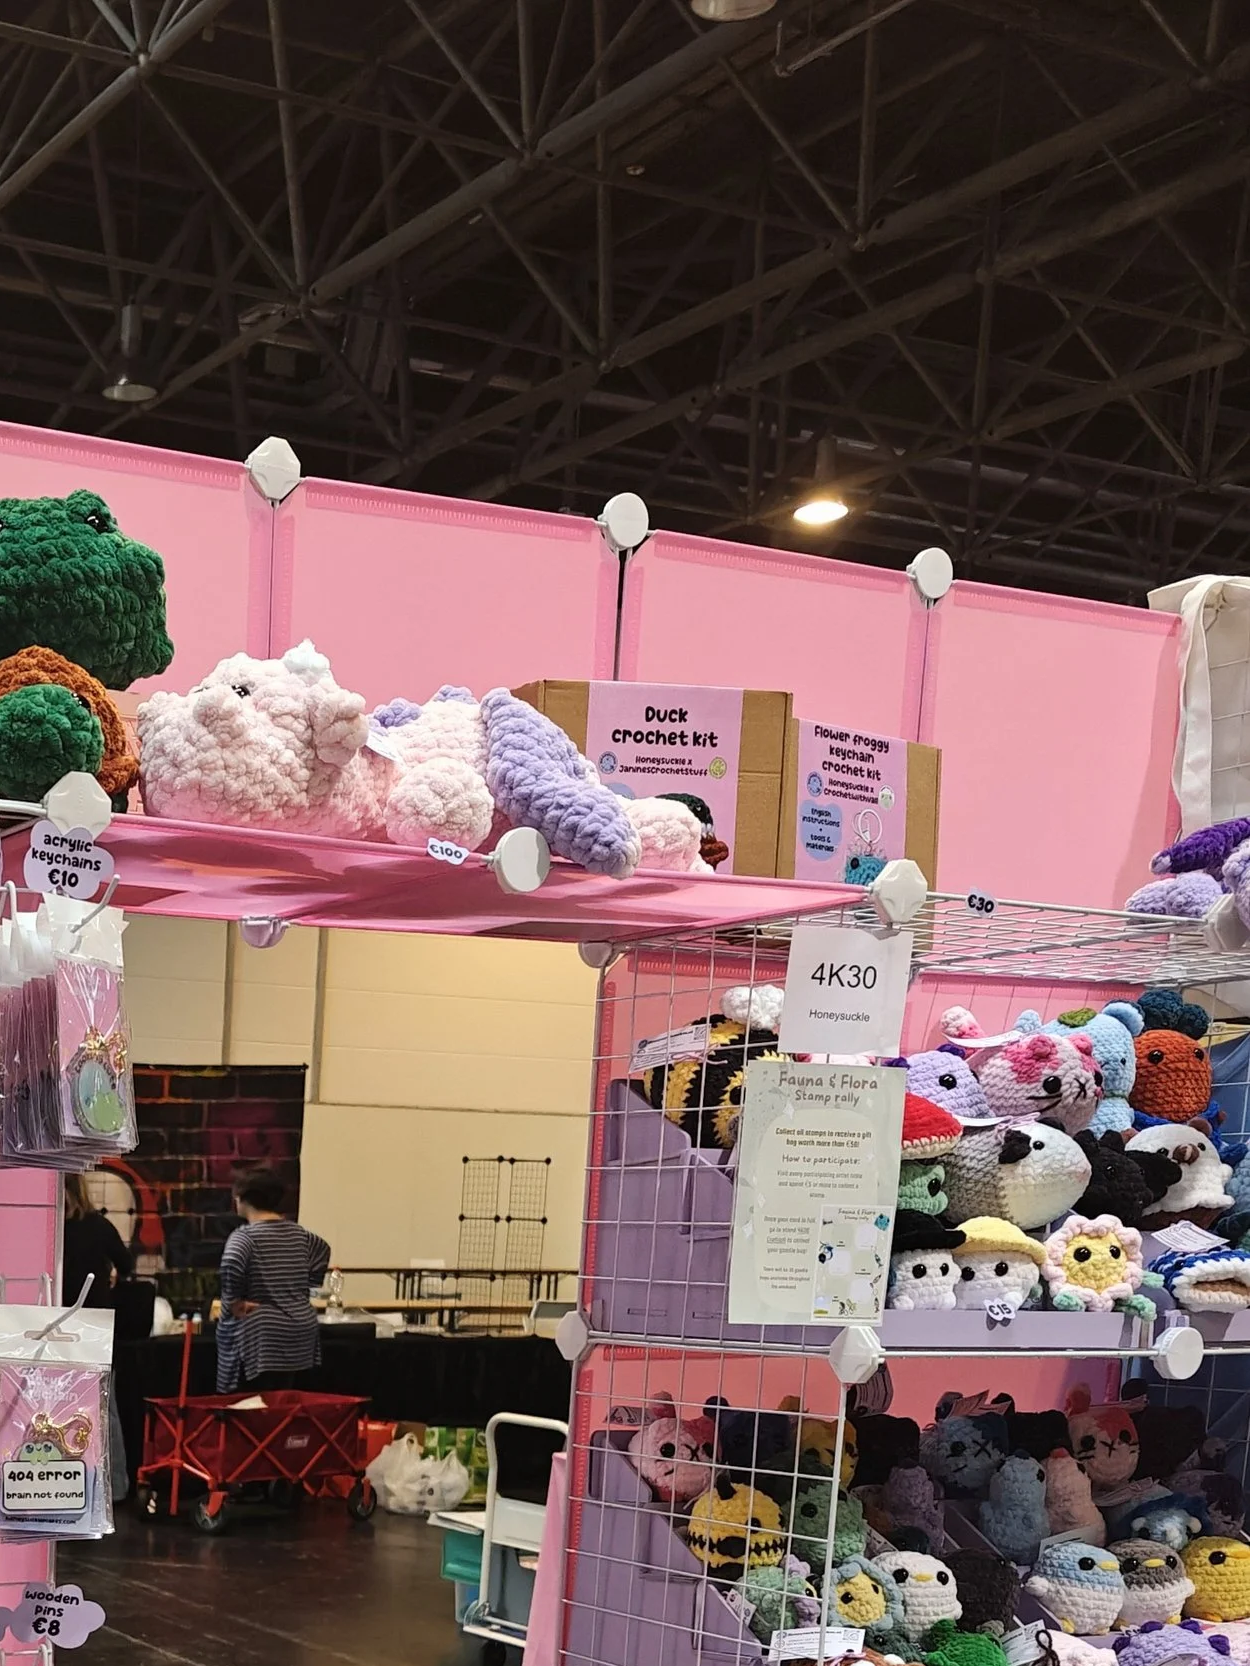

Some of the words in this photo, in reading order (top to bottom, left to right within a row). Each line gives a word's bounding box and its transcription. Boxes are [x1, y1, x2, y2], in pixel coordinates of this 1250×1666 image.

[645, 706, 688, 723] Duck
[611, 728, 693, 746] crochet
[693, 730, 719, 748] kit
[815, 725, 850, 743] Flower
[853, 734, 889, 753] froggy
[635, 756, 684, 766] Honeysuckle
[829, 746, 874, 764] keychain
[822, 760, 865, 778] crochet
[867, 768, 881, 781] kit
[43, 832, 92, 853] acrylic
[428, 842, 463, 861] €100
[31, 848, 101, 872] keychains
[48, 869, 78, 888] €10
[967, 894, 994, 913] €30
[811, 962, 877, 989] 4K30
[809, 1009, 870, 1022] Honeysuckle
[778, 1072, 823, 1087] Fauna
[829, 1074, 836, 1089] &
[840, 1074, 878, 1089] Flora
[795, 1090, 831, 1106] Stamp
[835, 1093, 860, 1107] rally
[782, 1154, 800, 1162] How
[813, 1157, 860, 1166] participate:
[989, 1304, 1011, 1316] €15
[8, 1471, 34, 1482] 404
[38, 1470, 81, 1482] error
[6, 1491, 32, 1500] brain
[34, 1491, 52, 1499] not
[54, 1490, 84, 1499] found
[32, 1618, 60, 1636] €8
